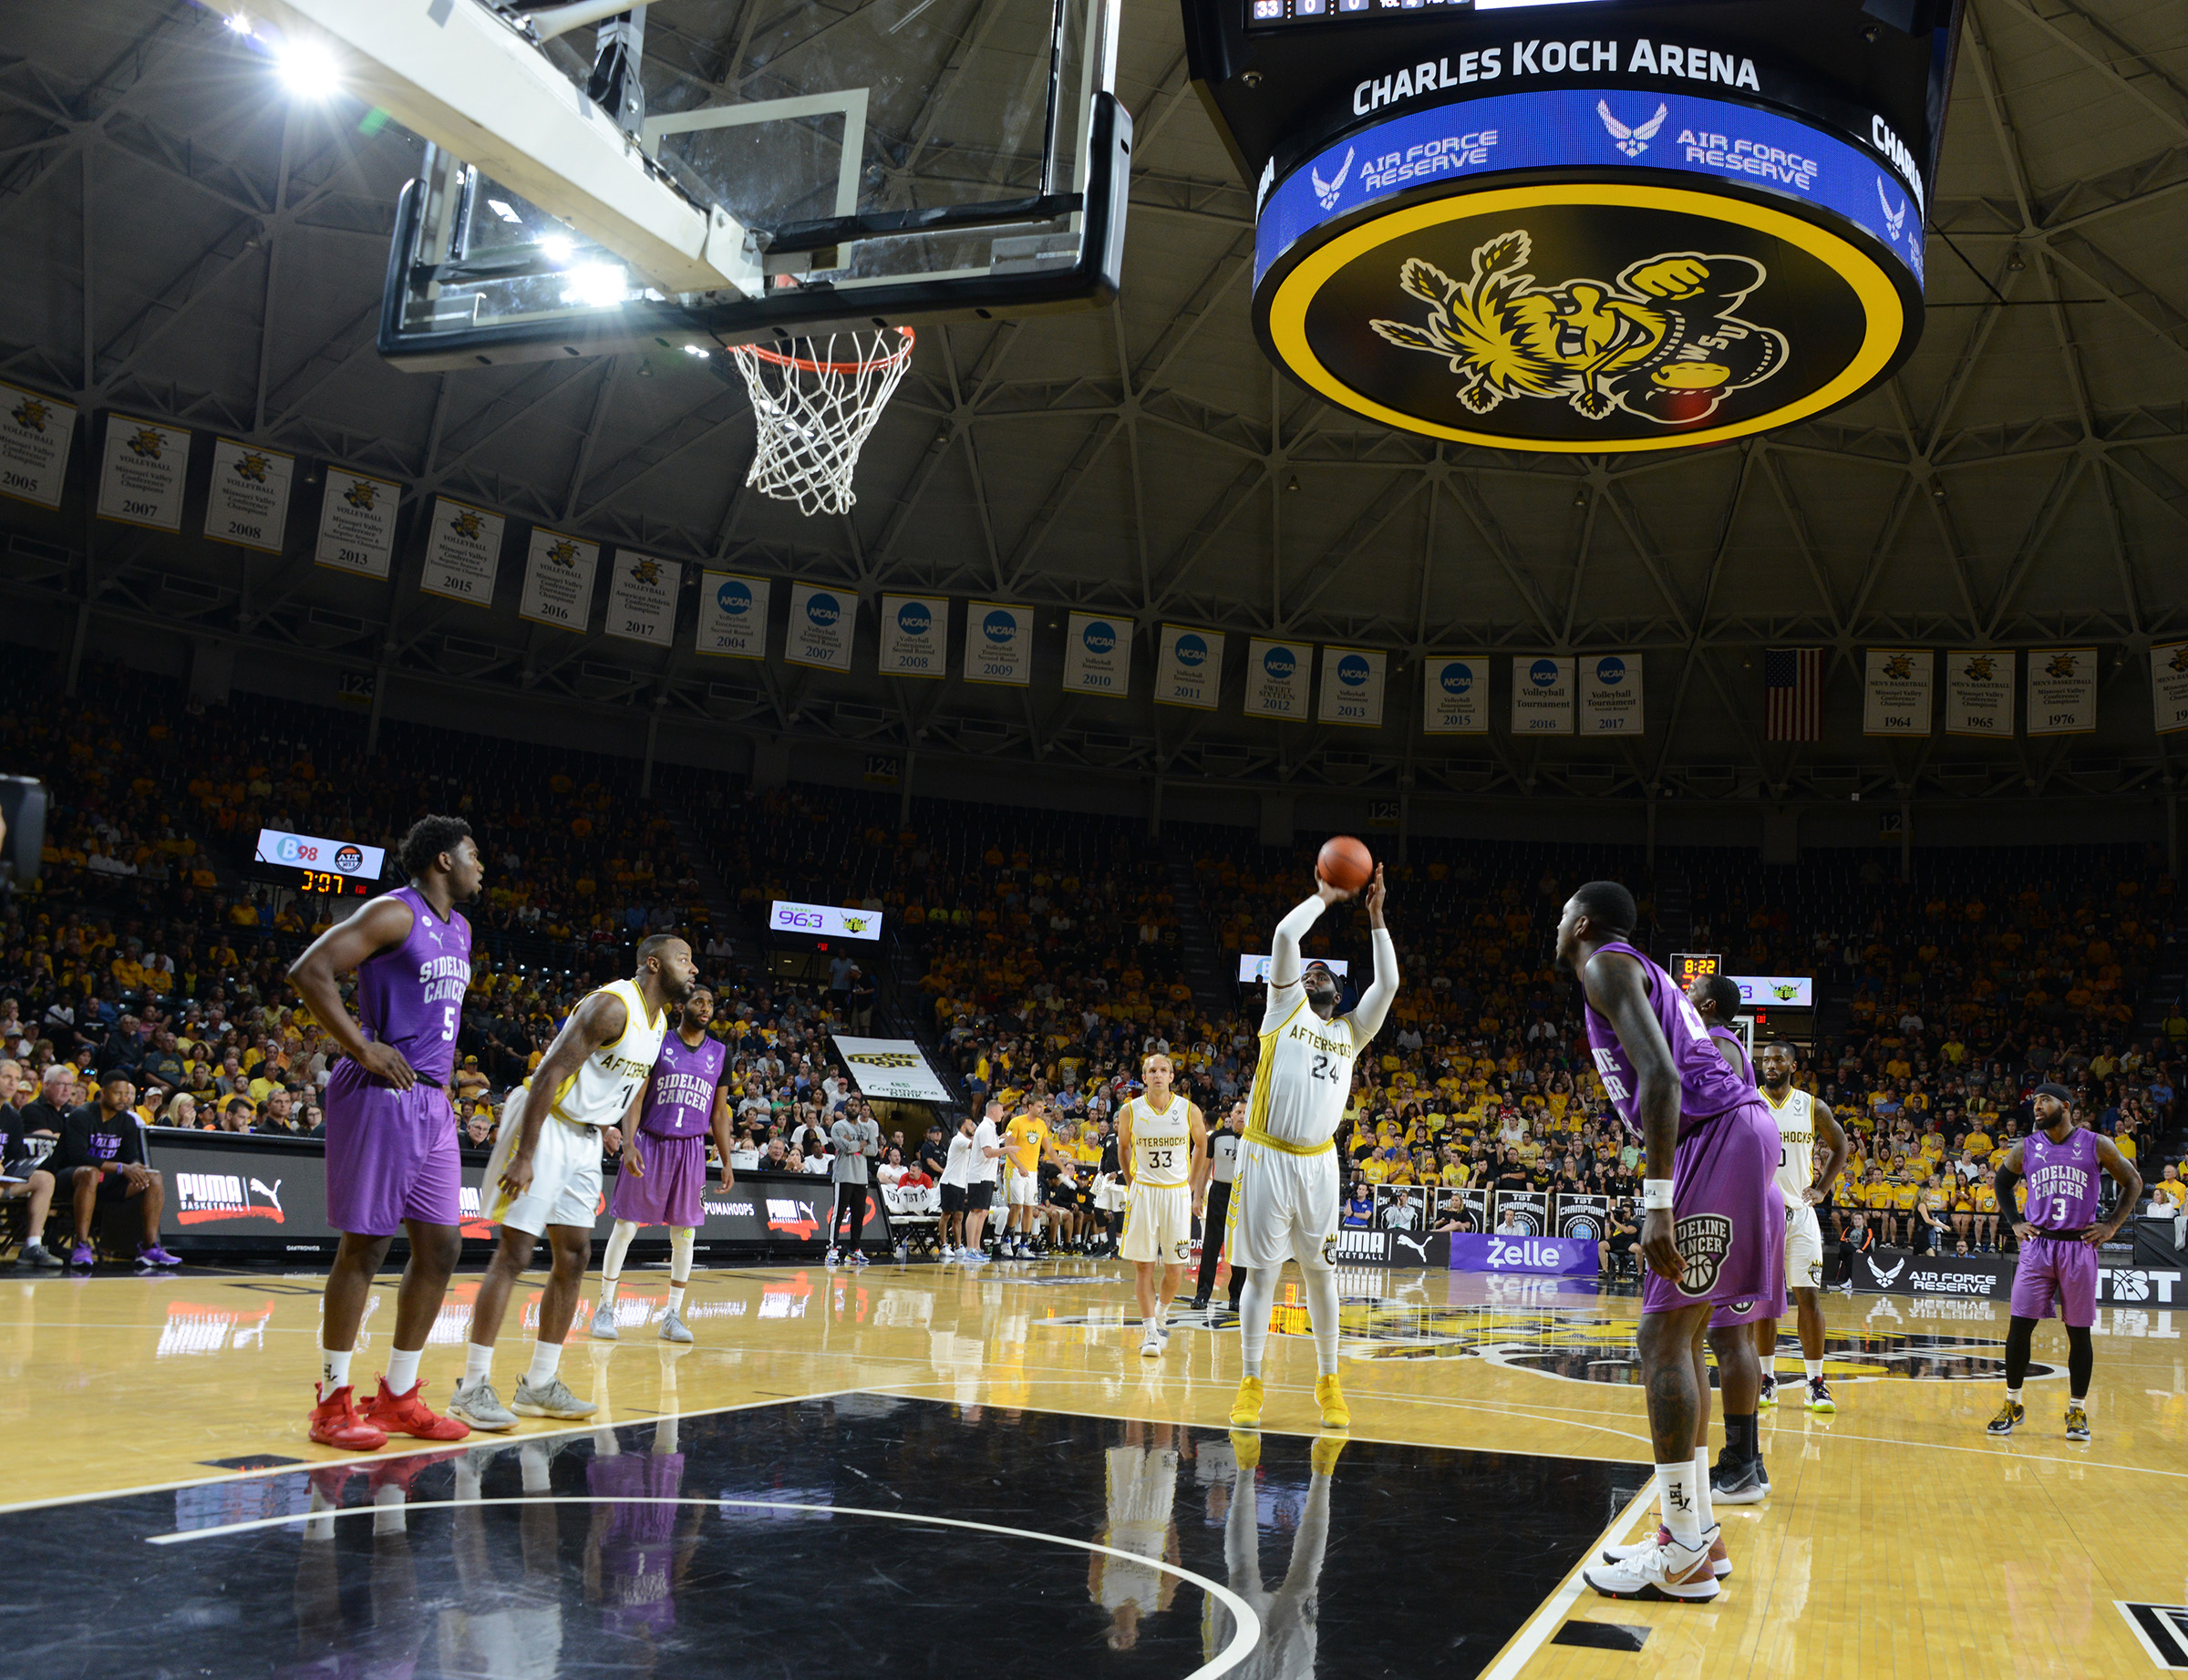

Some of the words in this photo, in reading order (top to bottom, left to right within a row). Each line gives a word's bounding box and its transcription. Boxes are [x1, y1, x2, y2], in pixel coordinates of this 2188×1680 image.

[1257, 2, 1278, 16] 33
[1353, 47, 1502, 116] CHARLES
[1512, 40, 1617, 76] KOCH
[1628, 39, 1760, 92] ARENA
[1360, 151, 1402, 180] AIR
[1406, 129, 1498, 162] FORCE
[1677, 129, 1729, 150] AIR
[1734, 139, 1818, 178] FORCE
[1365, 147, 1488, 192] RESERVE
[1686, 145, 1811, 191] RESERVE
[1676, 324, 1749, 362] WSU
[3, 425, 54, 445] VOLLEYBALL
[119, 454, 171, 471] VOLLEYBALL
[3, 471, 38, 491] 2005
[115, 465, 149, 479] Missouri
[150, 471, 174, 483] Valley
[121, 473, 166, 488] Conference
[120, 479, 164, 494] Champions
[227, 478, 274, 495] VOLLEYBALL
[222, 488, 253, 501] Missouri
[254, 494, 276, 507] Valley
[228, 496, 269, 510] Conference
[122, 500, 158, 517] 2007
[227, 501, 268, 517] Champions
[336, 505, 382, 523] VOLLEYBALL
[228, 521, 262, 540] 2008
[332, 515, 363, 530] Missouri
[363, 521, 384, 534] Valley
[338, 523, 377, 538] Conference
[443, 534, 487, 551] VOLLEYBALL
[338, 548, 368, 566] 2013
[439, 543, 468, 558] Missouri
[468, 551, 488, 562] Valley
[444, 551, 480, 566] Conference
[540, 563, 583, 580] VOLLEYBALL
[443, 576, 472, 593] 2015
[536, 572, 563, 585] Missouri
[564, 578, 583, 590] Valley
[541, 579, 576, 593] Conference
[539, 584, 576, 599] Tournament
[624, 582, 666, 596] VOLLEYBALL
[539, 592, 574, 605] Champions
[615, 590, 646, 602] American
[647, 596, 671, 607] Athletic
[625, 598, 661, 610] Conference
[720, 595, 751, 608] NCAA
[541, 603, 568, 620] 2016
[624, 603, 660, 616] Champions
[810, 608, 839, 619] NCAA
[625, 621, 655, 635] 2017
[901, 617, 931, 627] NCAA
[807, 626, 836, 636] Volleyball
[986, 625, 1015, 635] NCAA
[717, 635, 746, 649] 2004
[899, 635, 929, 644] Volleyball
[1086, 635, 1115, 647] NCAA
[805, 645, 834, 661] 2007
[1178, 648, 1206, 659] NCAA
[899, 656, 929, 668] 2008
[1266, 661, 1295, 672] NCAA
[984, 664, 1013, 676] 2009
[1340, 669, 1369, 679] NCAA
[1533, 672, 1558, 680] NCAA
[1600, 669, 1626, 678] NCAA
[1083, 674, 1111, 686] 2010
[1444, 678, 1472, 686] NCAA
[1174, 686, 1201, 699] 2011
[1259, 690, 1295, 701] SIXTEEN
[1264, 685, 1293, 694] SWEET
[1522, 688, 1564, 698] Volleyball
[1592, 690, 1631, 700] Volleyball
[1263, 698, 1290, 711] 2012
[1516, 700, 1570, 708] Tournament
[1586, 698, 1636, 707] Tournament
[1337, 706, 1366, 717] 2013
[1443, 715, 1471, 726] 2015
[1530, 719, 1556, 729] 2016
[1599, 718, 1625, 729] 2017
[1884, 716, 1911, 727] 1964
[1967, 716, 1994, 728] 1965
[2049, 714, 2075, 726] 1976
[868, 756, 897, 777] 124
[1370, 802, 1399, 819] 125
[283, 838, 318, 862] B98
[337, 853, 360, 862] ALT
[356, 885, 366, 894] EXIT
[779, 911, 823, 928] 96.3
[1684, 959, 1716, 974] 8:22
[1784, 990, 1798, 998] BULL
[442, 1006, 455, 1041] 5
[1756, 1015, 1766, 1024] EXIT
[1311, 1055, 1339, 1085] 24
[656, 1073, 713, 1100] SIDELINE
[869, 1084, 938, 1095] Commerce
[657, 1088, 707, 1114] CANCER
[676, 1107, 684, 1128] 1
[1136, 1137, 1186, 1147] AFTERSHOCKS
[1149, 1150, 1172, 1169] 33
[2031, 1165, 2088, 1188] SIDELINE
[176, 1172, 243, 1203] PUMA
[2035, 1180, 2083, 1201] CANCER
[1512, 1193, 1532, 1201] TBT
[1574, 1196, 1593, 1204] TBT
[181, 1201, 243, 1211] BASKETBALL
[766, 1199, 799, 1218] PUMA
[1499, 1201, 1544, 1215] CHAMPIONS
[1560, 1205, 1605, 1218] CHAMPIONS
[2052, 1198, 2066, 1221] 3
[1569, 1219, 1595, 1229] OVERSEAS
[1337, 1230, 1385, 1253] UMA
[1678, 1236, 1723, 1257] ANCER
[1338, 1252, 1384, 1261] KETBALL
[1486, 1237, 1560, 1268] Zelle
[1909, 1271, 1938, 1282] AIR
[1941, 1273, 1997, 1284] FORCE
[1914, 1280, 1991, 1293] RESERVE
[2095, 1268, 2181, 1303] TBT
